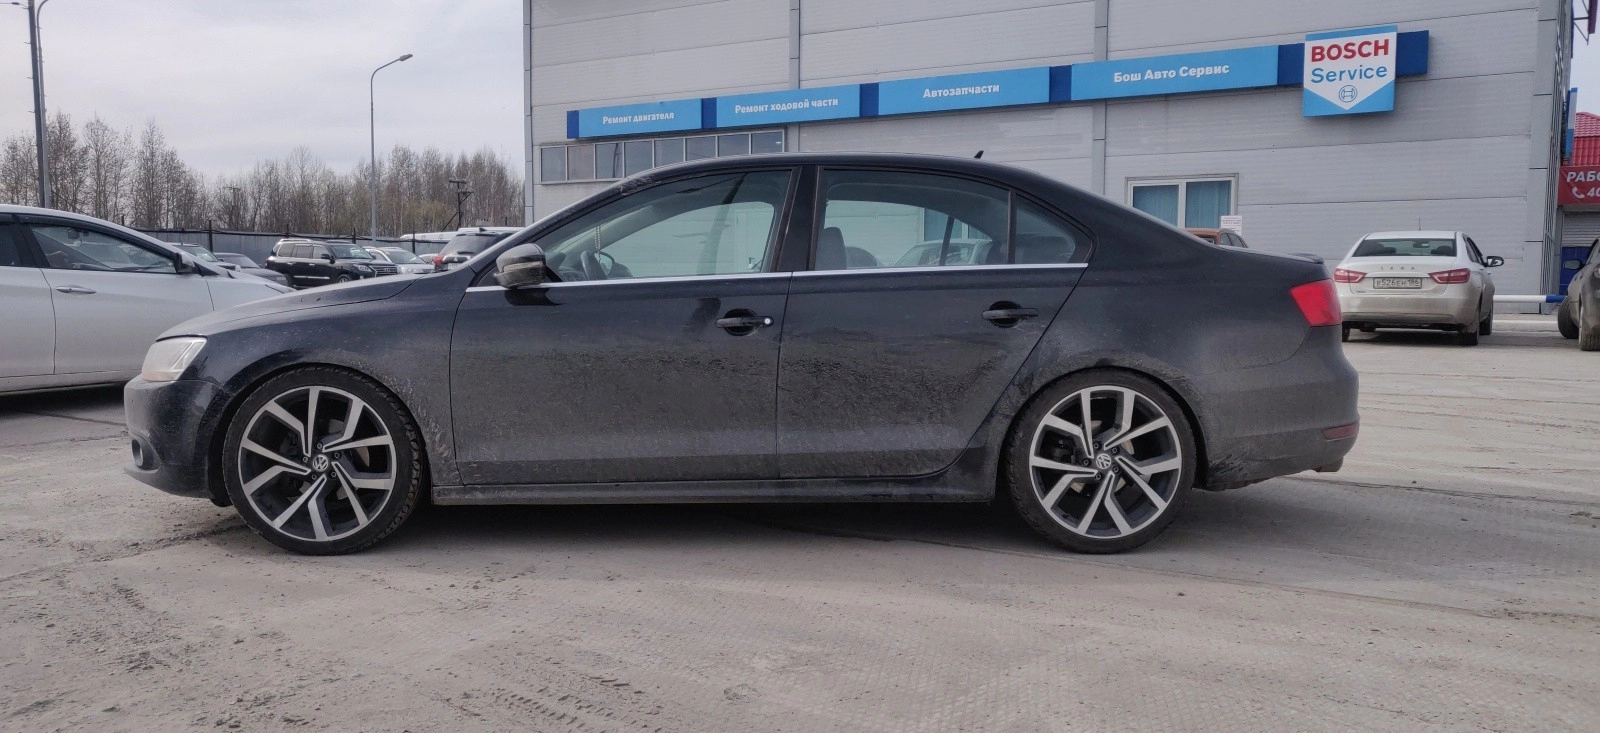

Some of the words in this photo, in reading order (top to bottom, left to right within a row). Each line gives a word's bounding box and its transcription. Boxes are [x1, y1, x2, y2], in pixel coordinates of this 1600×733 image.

[1311, 38, 1390, 62] BOSCH
[1113, 70, 1142, 83] Бош
[1144, 67, 1176, 81] Авто
[1179, 63, 1230, 78] Сервис
[1310, 64, 1388, 83] Service
[922, 82, 1000, 98] Автозапчасти
[735, 103, 769, 114] Ремонт
[770, 98, 810, 112] ходовой
[811, 97, 839, 108] части
[602, 115, 633, 125] Ремонт
[633, 111, 675, 123] двигателя
